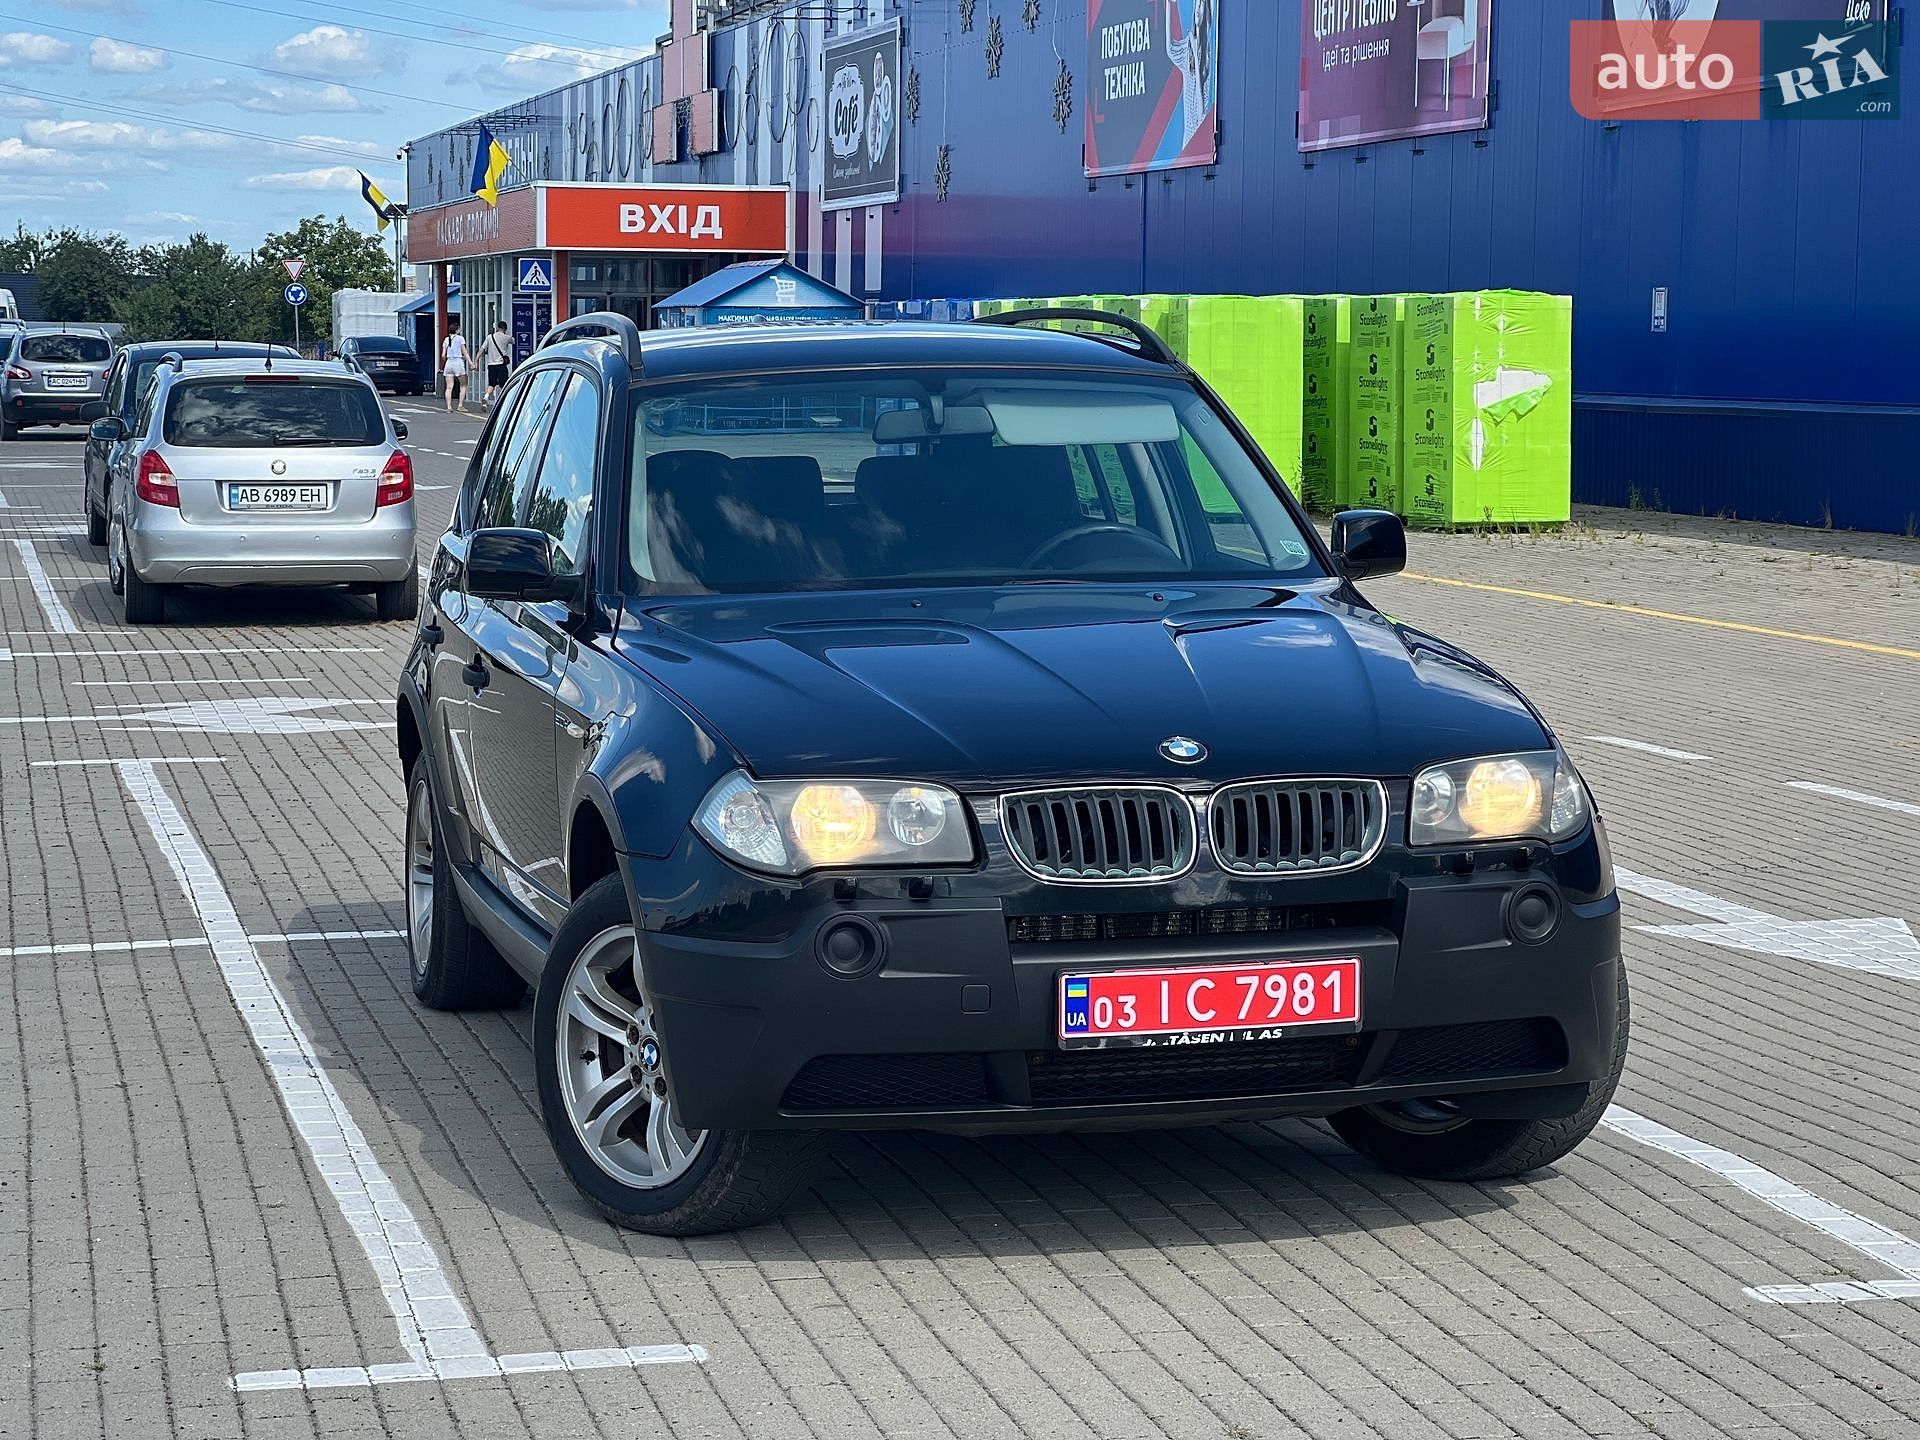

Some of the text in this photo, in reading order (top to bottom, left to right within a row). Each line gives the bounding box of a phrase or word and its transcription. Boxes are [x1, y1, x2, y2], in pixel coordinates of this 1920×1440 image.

[1101, 17, 1151, 60] ПОБУТОВА
[1322, 39, 1390, 72] ідеї та рішення
[1104, 61, 1146, 101] ТЕХНІКА
[834, 93, 859, 147] Café
[619, 203, 723, 240] ВХІД
[239, 488, 321, 503] AB 6989 EH
[1093, 994, 1137, 1029] 03
[1234, 969, 1342, 1021] 7981
[1067, 1012, 1087, 1028] UA
[1258, 1028, 1283, 1040] AS
